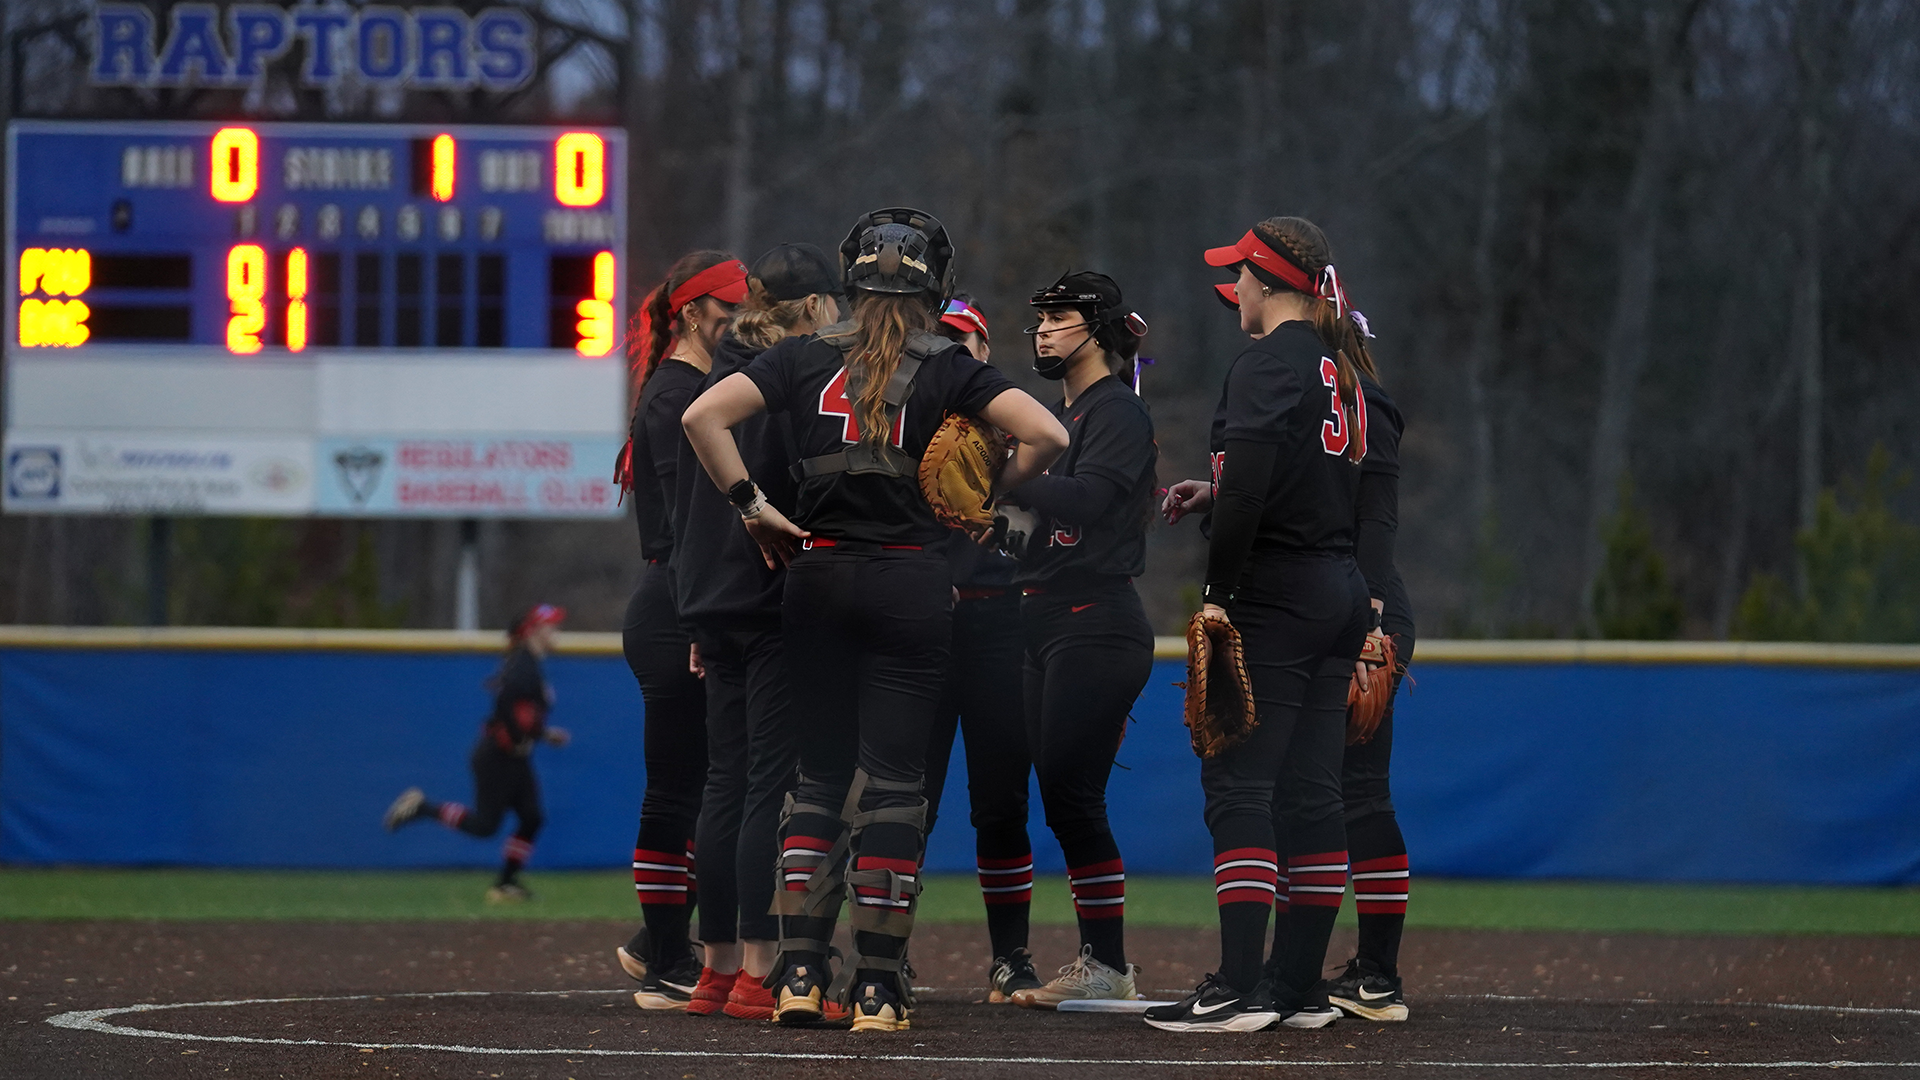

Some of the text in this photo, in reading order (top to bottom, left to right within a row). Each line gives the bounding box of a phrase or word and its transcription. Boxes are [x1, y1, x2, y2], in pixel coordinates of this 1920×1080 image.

[94, 7, 533, 86] RAPTORS
[211, 127, 258, 202] 0
[432, 133, 455, 201] 1
[555, 132, 604, 206] 0
[227, 245, 267, 301] 0
[287, 247, 307, 299] 1
[594, 251, 615, 301] 1
[227, 299, 614, 357] 2 1 3
[818, 358, 907, 448] 4
[396, 441, 572, 469] REGULATORS
[972, 440, 991, 467] A2000
[396, 477, 610, 508] BASEBALL CLUB
